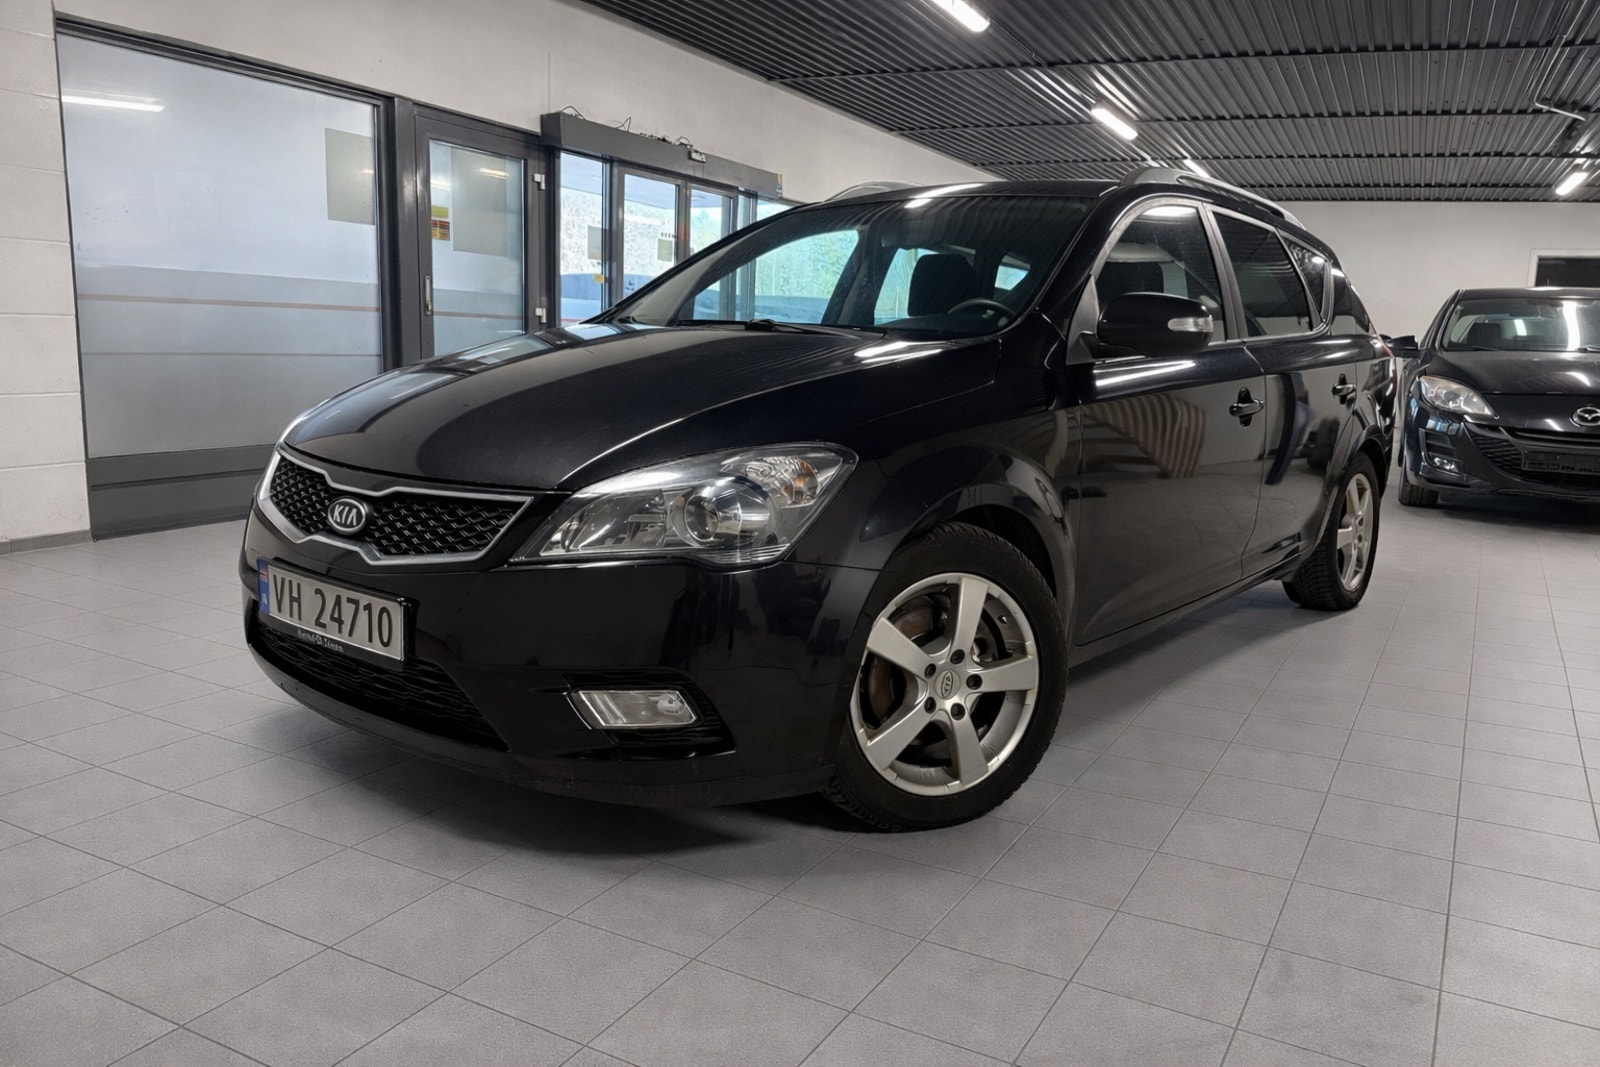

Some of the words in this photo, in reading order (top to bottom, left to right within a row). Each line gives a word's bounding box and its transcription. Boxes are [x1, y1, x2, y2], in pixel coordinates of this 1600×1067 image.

[333, 504, 357, 526] KIA
[273, 574, 302, 621] VH
[314, 587, 393, 648] 24710
